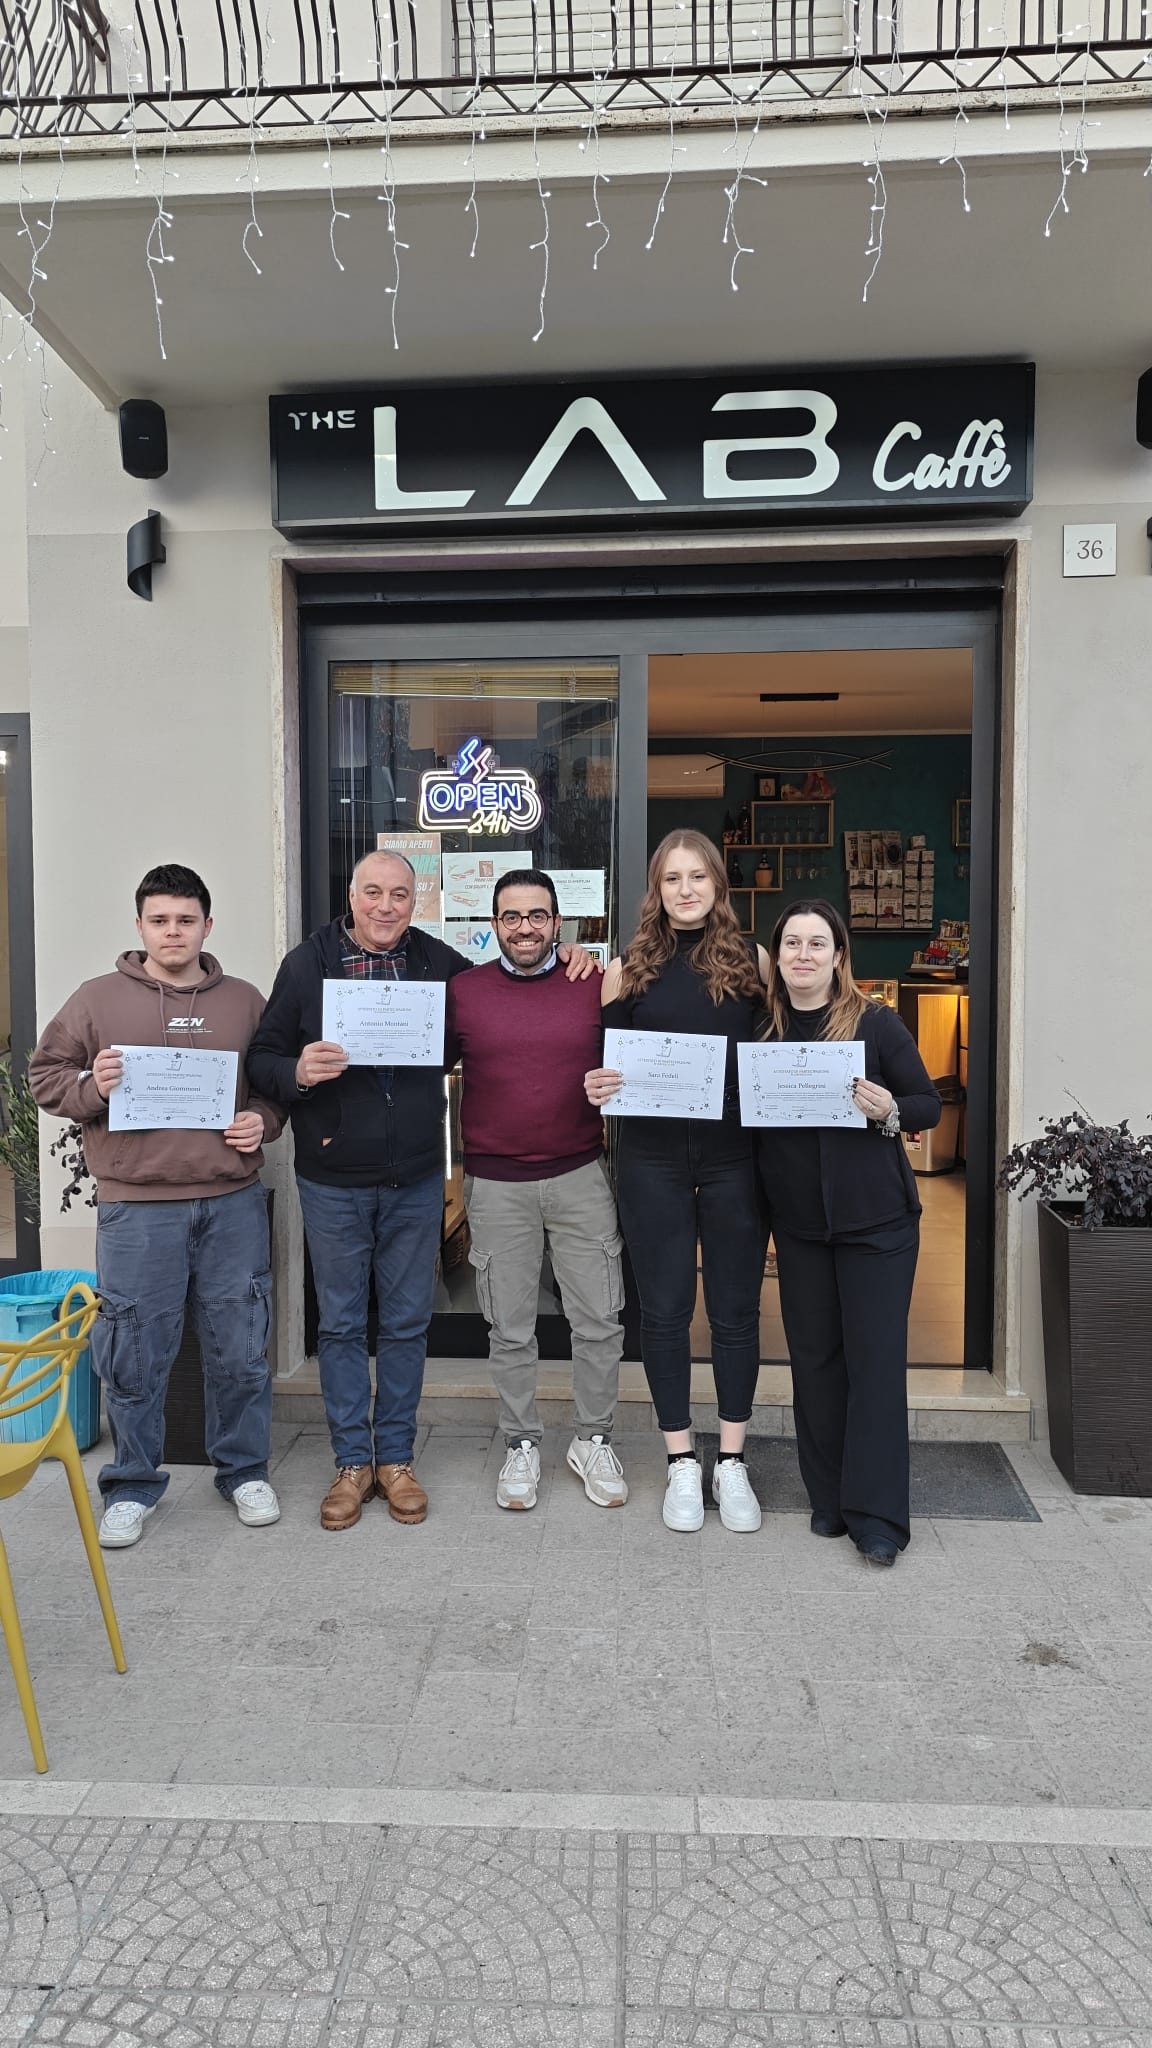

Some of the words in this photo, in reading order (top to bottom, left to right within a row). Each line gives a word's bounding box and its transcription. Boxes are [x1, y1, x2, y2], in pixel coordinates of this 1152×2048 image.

[288, 409, 357, 431] THE
[372, 389, 841, 511] LAB
[1077, 539, 1104, 560] 36
[429, 782, 522, 813] OPEN
[467, 810, 511, 835] 24h
[383, 839, 408, 849] SIAMO
[408, 839, 433, 849] APERTI
[455, 926, 492, 950] sky
